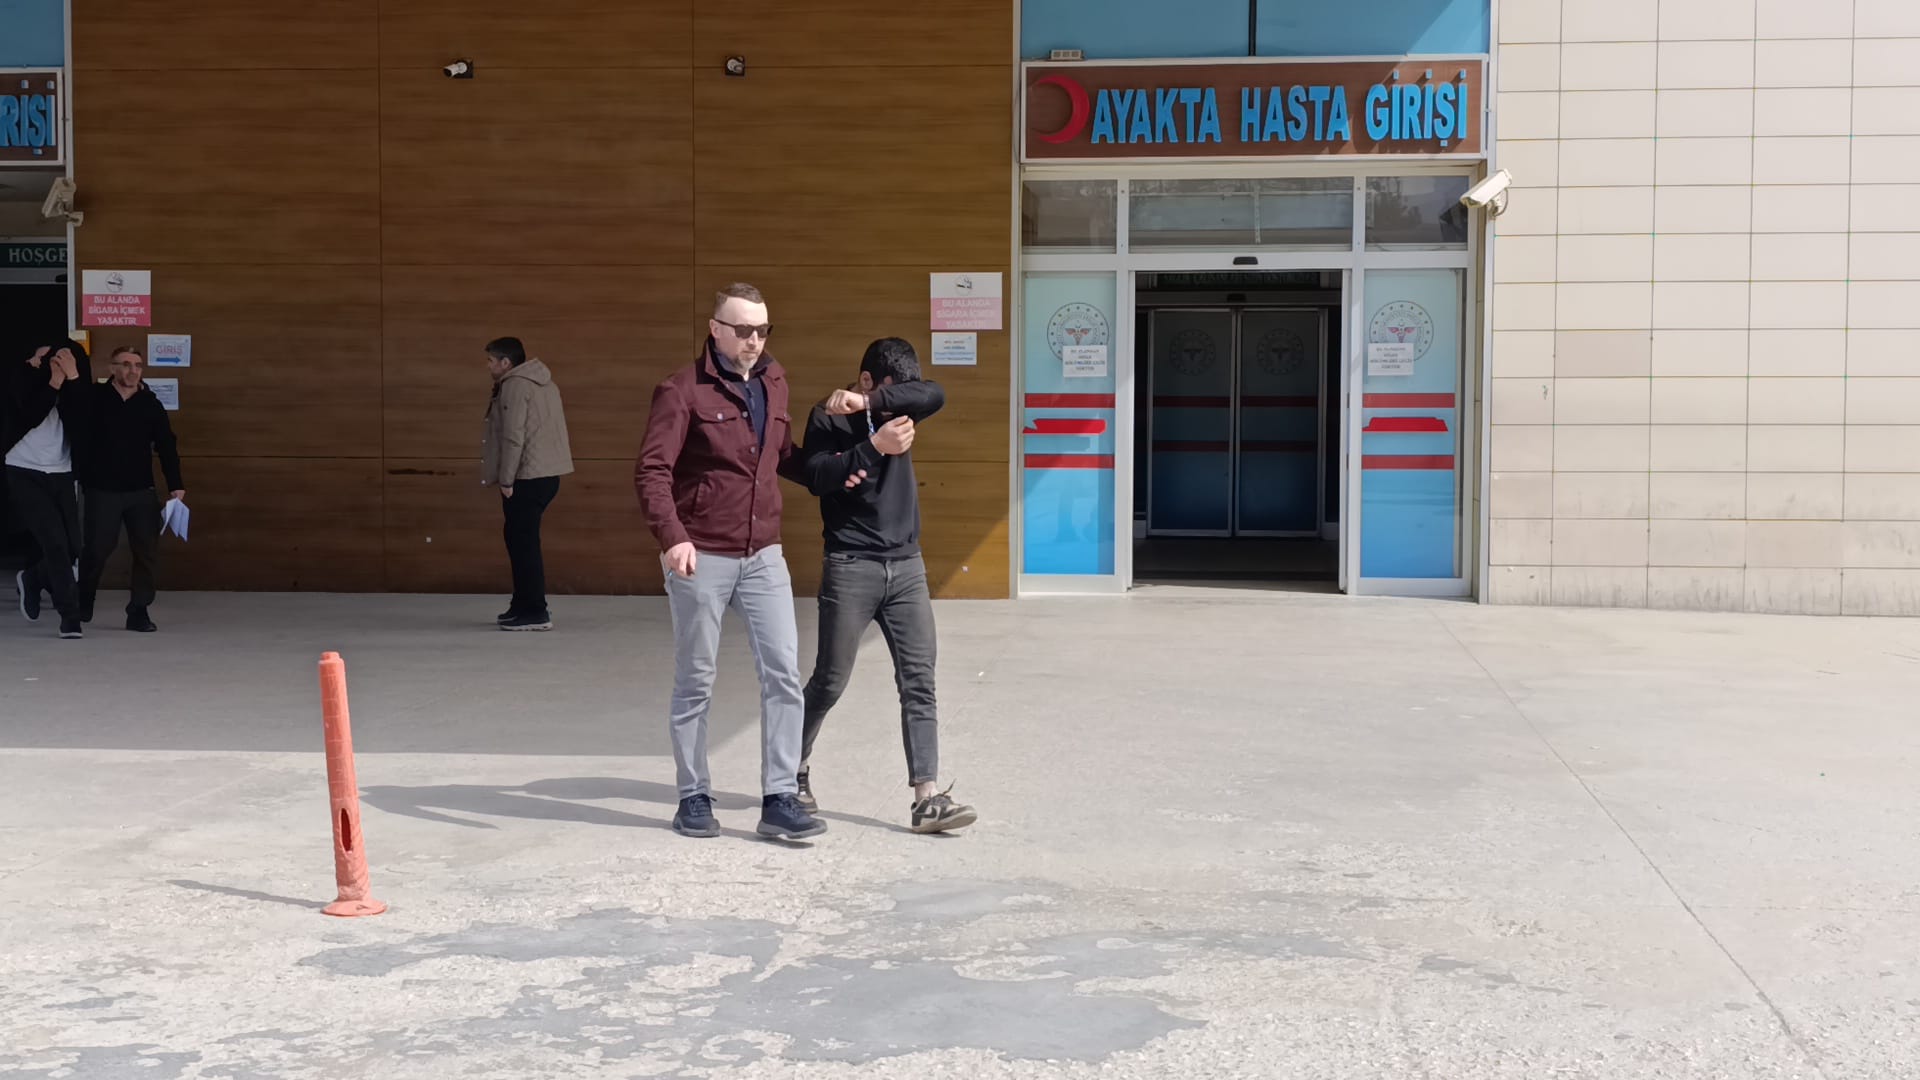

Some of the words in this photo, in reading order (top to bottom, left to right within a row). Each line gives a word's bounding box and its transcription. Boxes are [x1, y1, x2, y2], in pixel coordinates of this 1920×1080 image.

[1090, 88, 1222, 144] AYAKTA
[1240, 85, 1351, 142] HASTA
[1365, 70, 1468, 147] GİRİŞİ
[94, 296, 105, 304] BU
[107, 296, 140, 304] ALANDA
[88, 305, 119, 314] SİGARA
